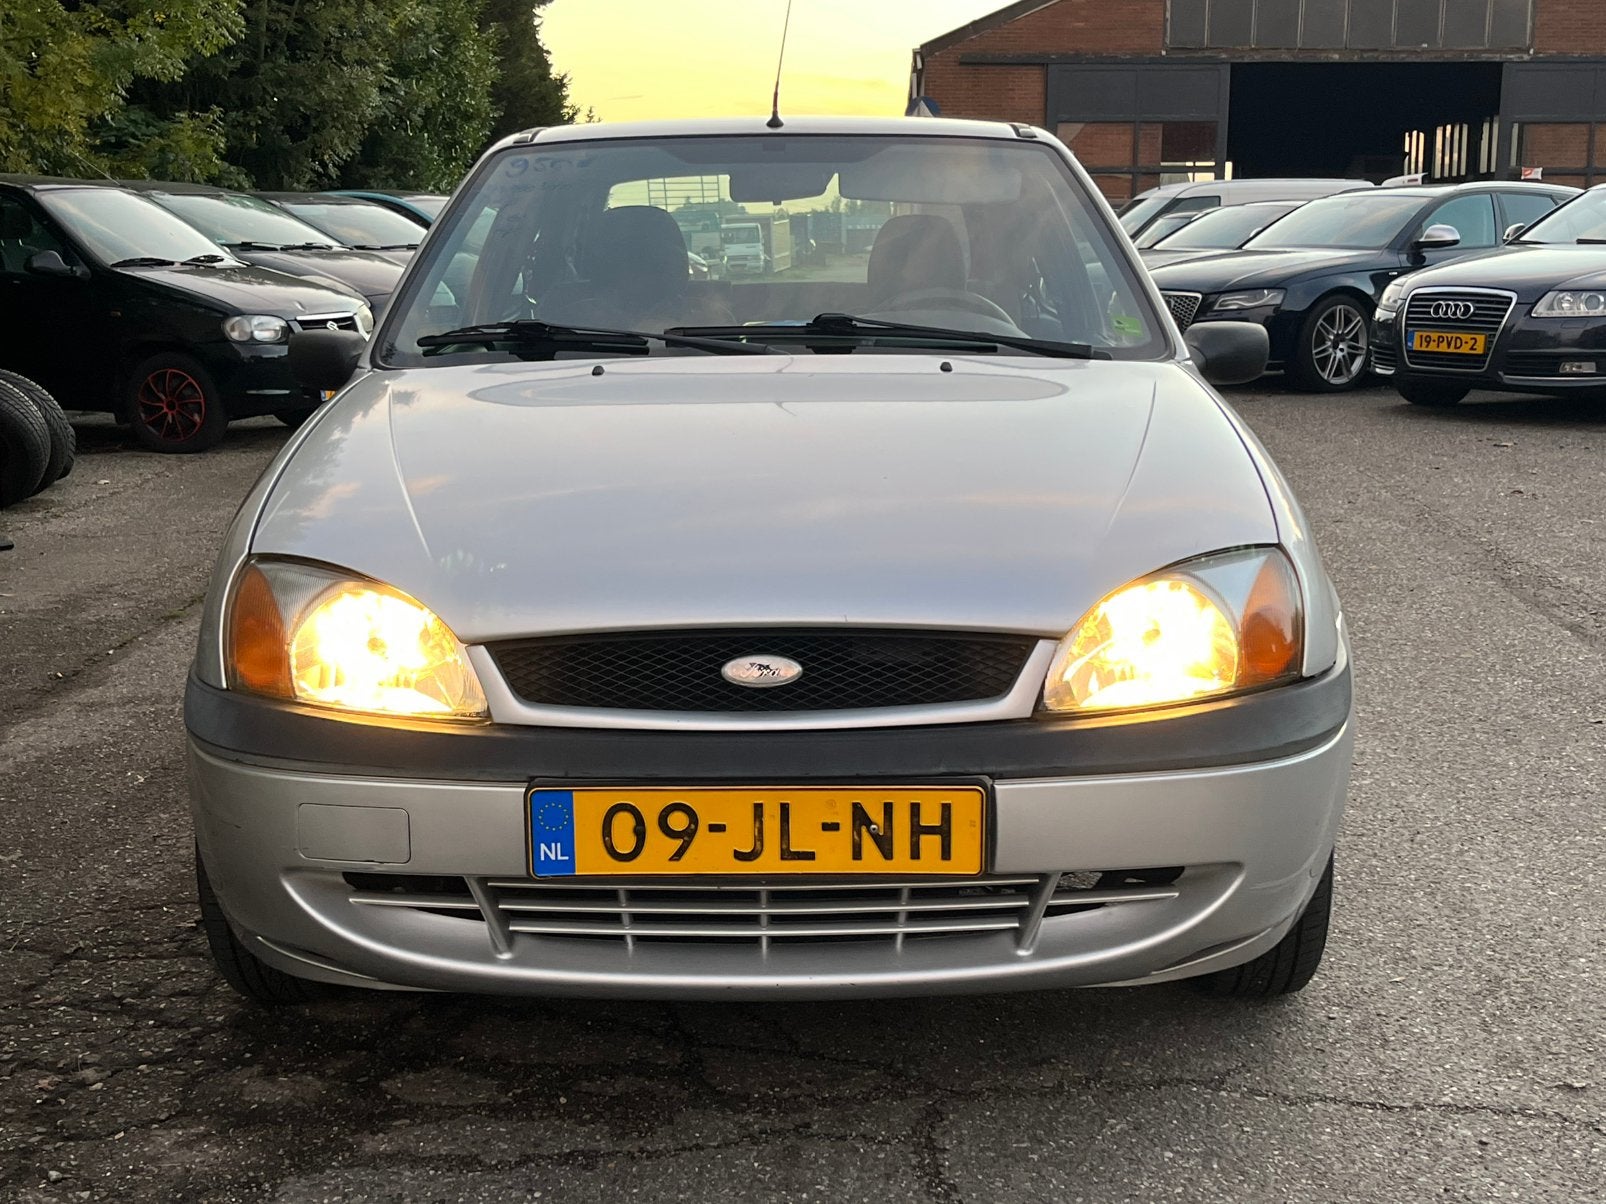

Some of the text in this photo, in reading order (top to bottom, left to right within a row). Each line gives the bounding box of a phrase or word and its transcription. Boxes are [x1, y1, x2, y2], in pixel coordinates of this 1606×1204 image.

[1419, 335, 1478, 351] 19-PVD-2
[602, 802, 952, 862] 09-JL-NH
[540, 842, 569, 861] NL
